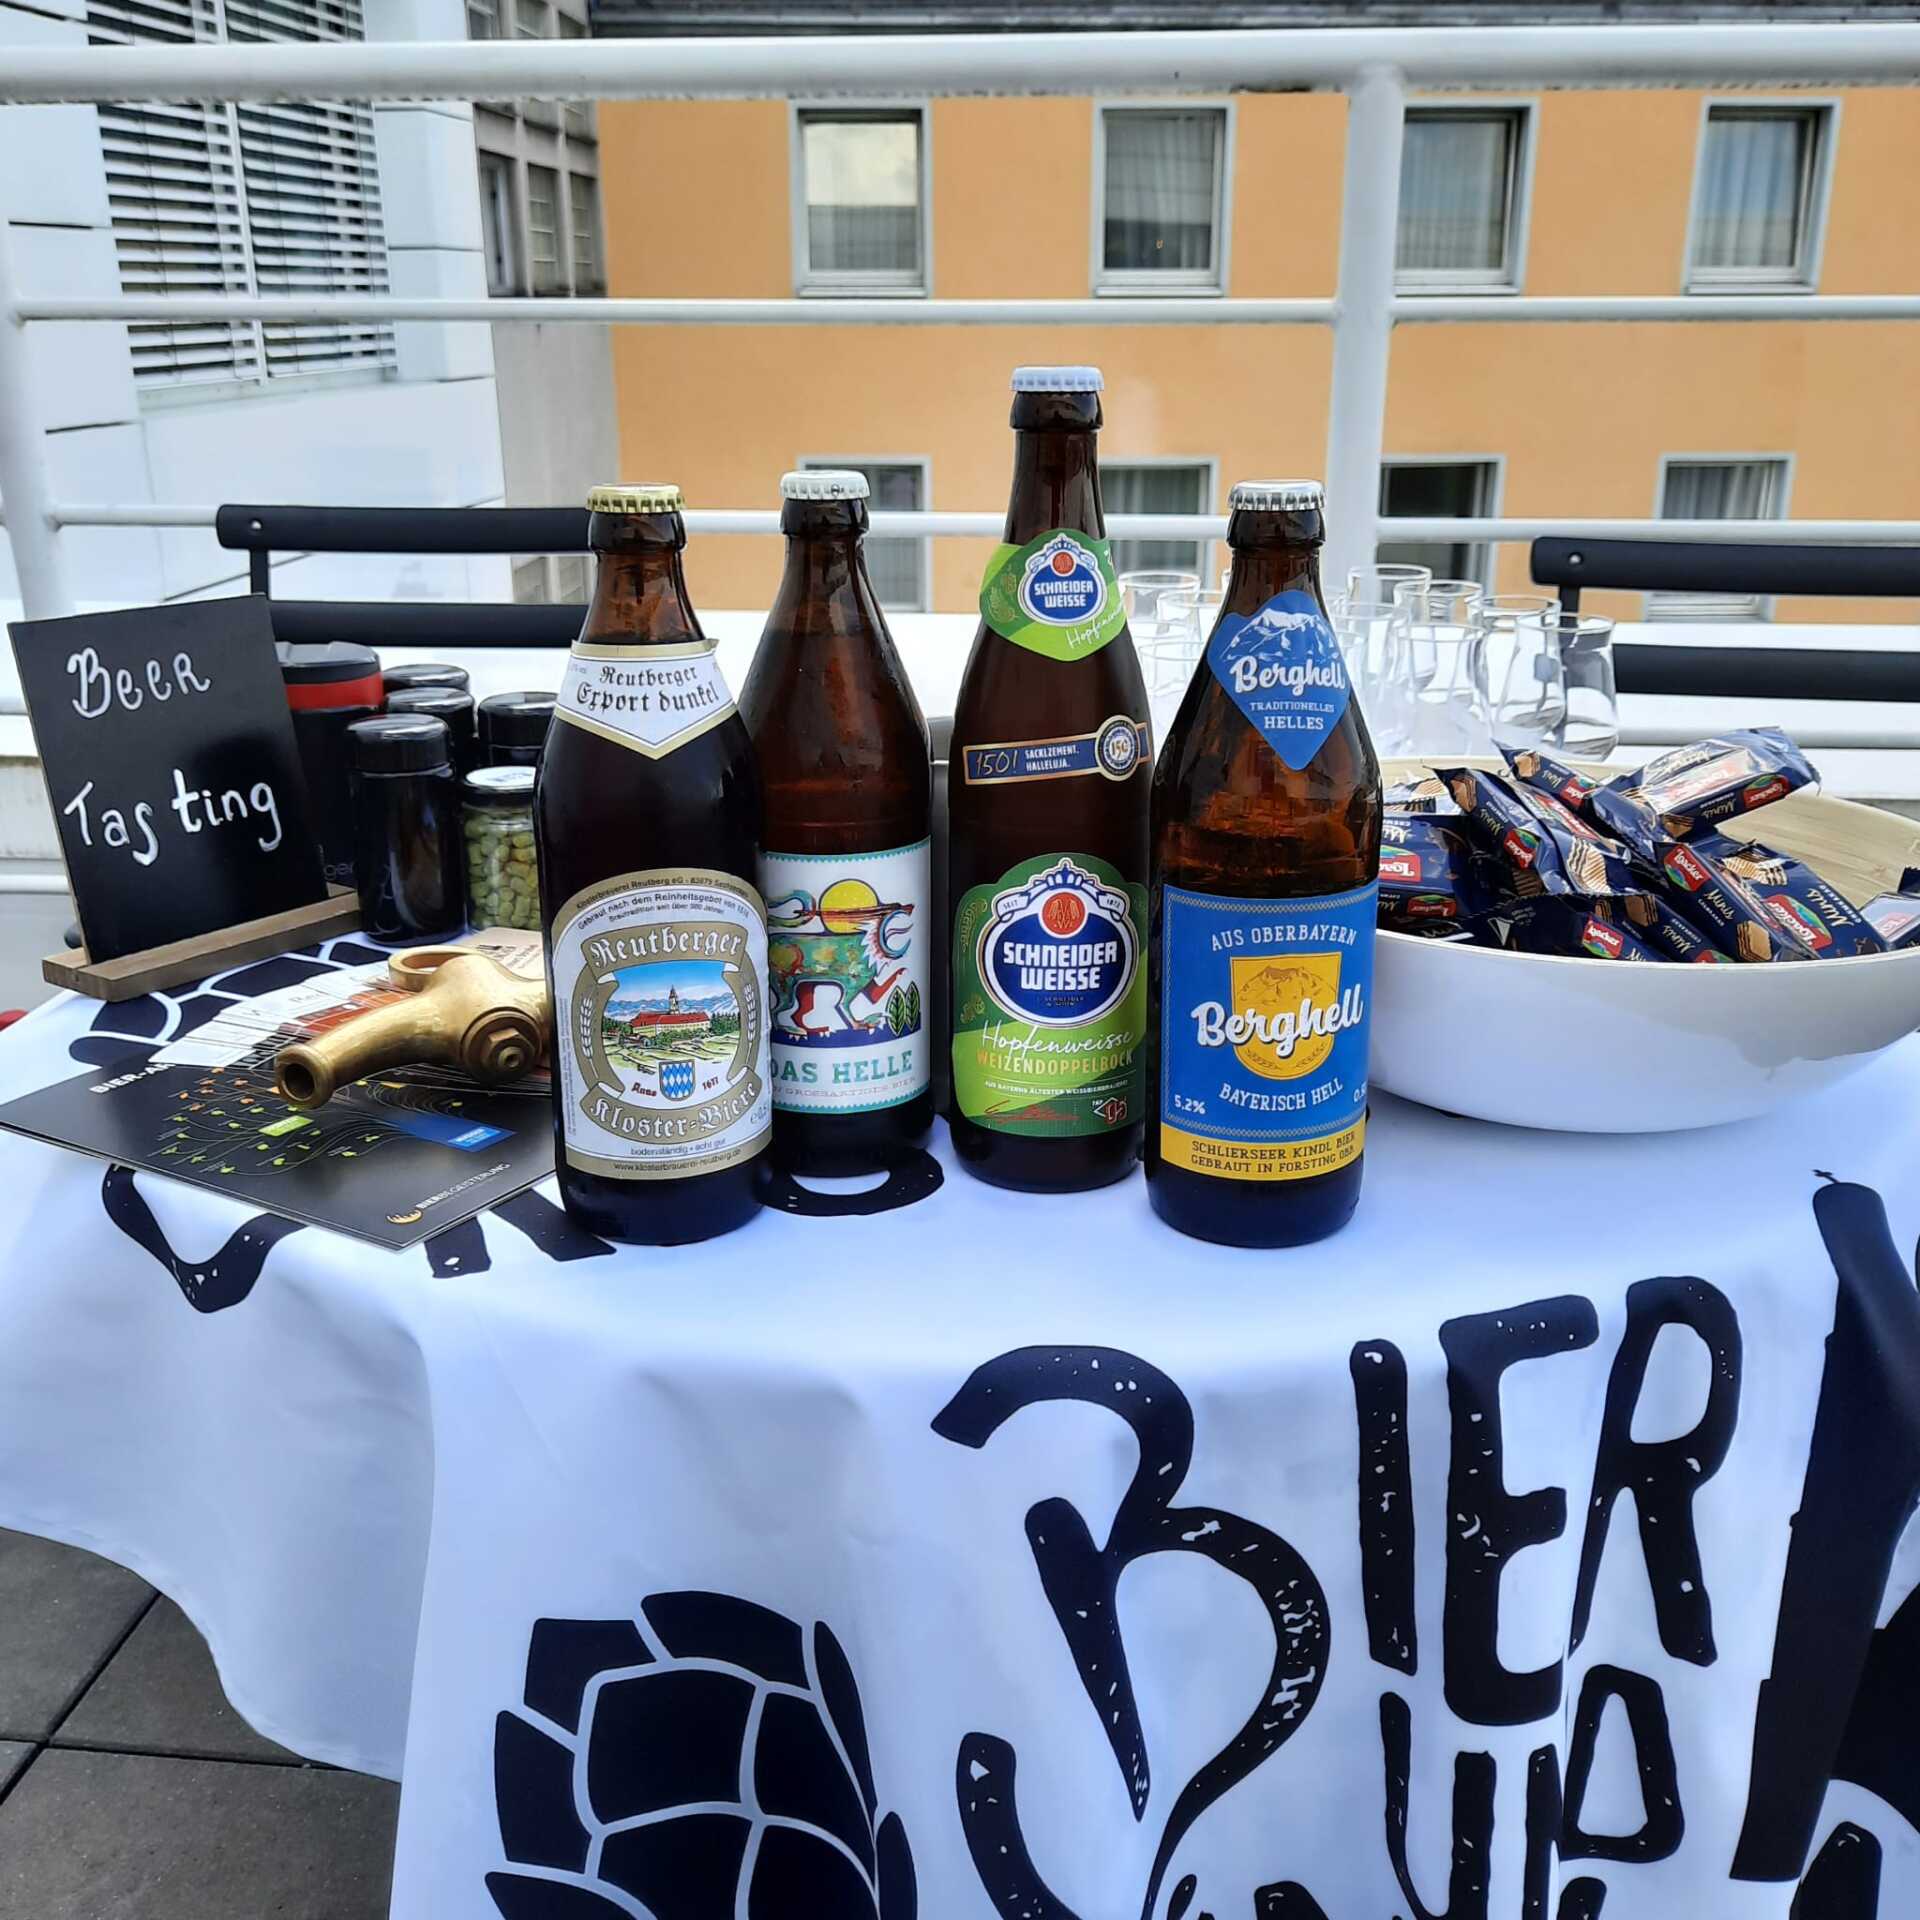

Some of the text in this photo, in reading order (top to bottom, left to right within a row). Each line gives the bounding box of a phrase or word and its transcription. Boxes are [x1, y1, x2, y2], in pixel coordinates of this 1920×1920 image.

[1034, 580, 1094, 596] SCHNEIDER
[1044, 594, 1086, 609] WEISSE
[600, 666, 698, 688] Reutberger
[1229, 655, 1346, 697] Berghell
[577, 681, 719, 713] Export dunkel
[1250, 701, 1335, 713] TRADITIONELLES
[1264, 716, 1324, 730] HELLES
[1674, 849, 1703, 881] Loacker
[608, 900, 629, 913] nach
[631, 895, 652, 906] dem
[655, 892, 722, 905] Reinheitsgebot
[1704, 887, 1737, 921] Minis
[1807, 889, 1855, 928] Minis
[1211, 924, 1358, 951] AUS OBERBAYERN
[1767, 902, 1817, 947] Loacker
[590, 926, 742, 969] Reutberger
[1003, 941, 1118, 967] SCHNEIDER
[1021, 966, 1101, 990] WEISSE
[1190, 983, 1364, 1058] Berghell
[982, 1019, 1134, 1060] Hopfenweisse
[832, 1050, 912, 1084] HELLE
[976, 1049, 1134, 1077] WEIZENDOPPELBOCK
[631, 1081, 658, 1098] Anno
[1218, 1077, 1344, 1112] BAYERISCH HELL
[1191, 1130, 1355, 1160] SCHLIERSEER KINDL BIER
[1191, 1154, 1252, 1173] GEBRAUT
[1257, 1161, 1274, 1174] IN
[1279, 1154, 1337, 1173] FORSTING
[930, 1275, 1741, 1920] BIER
